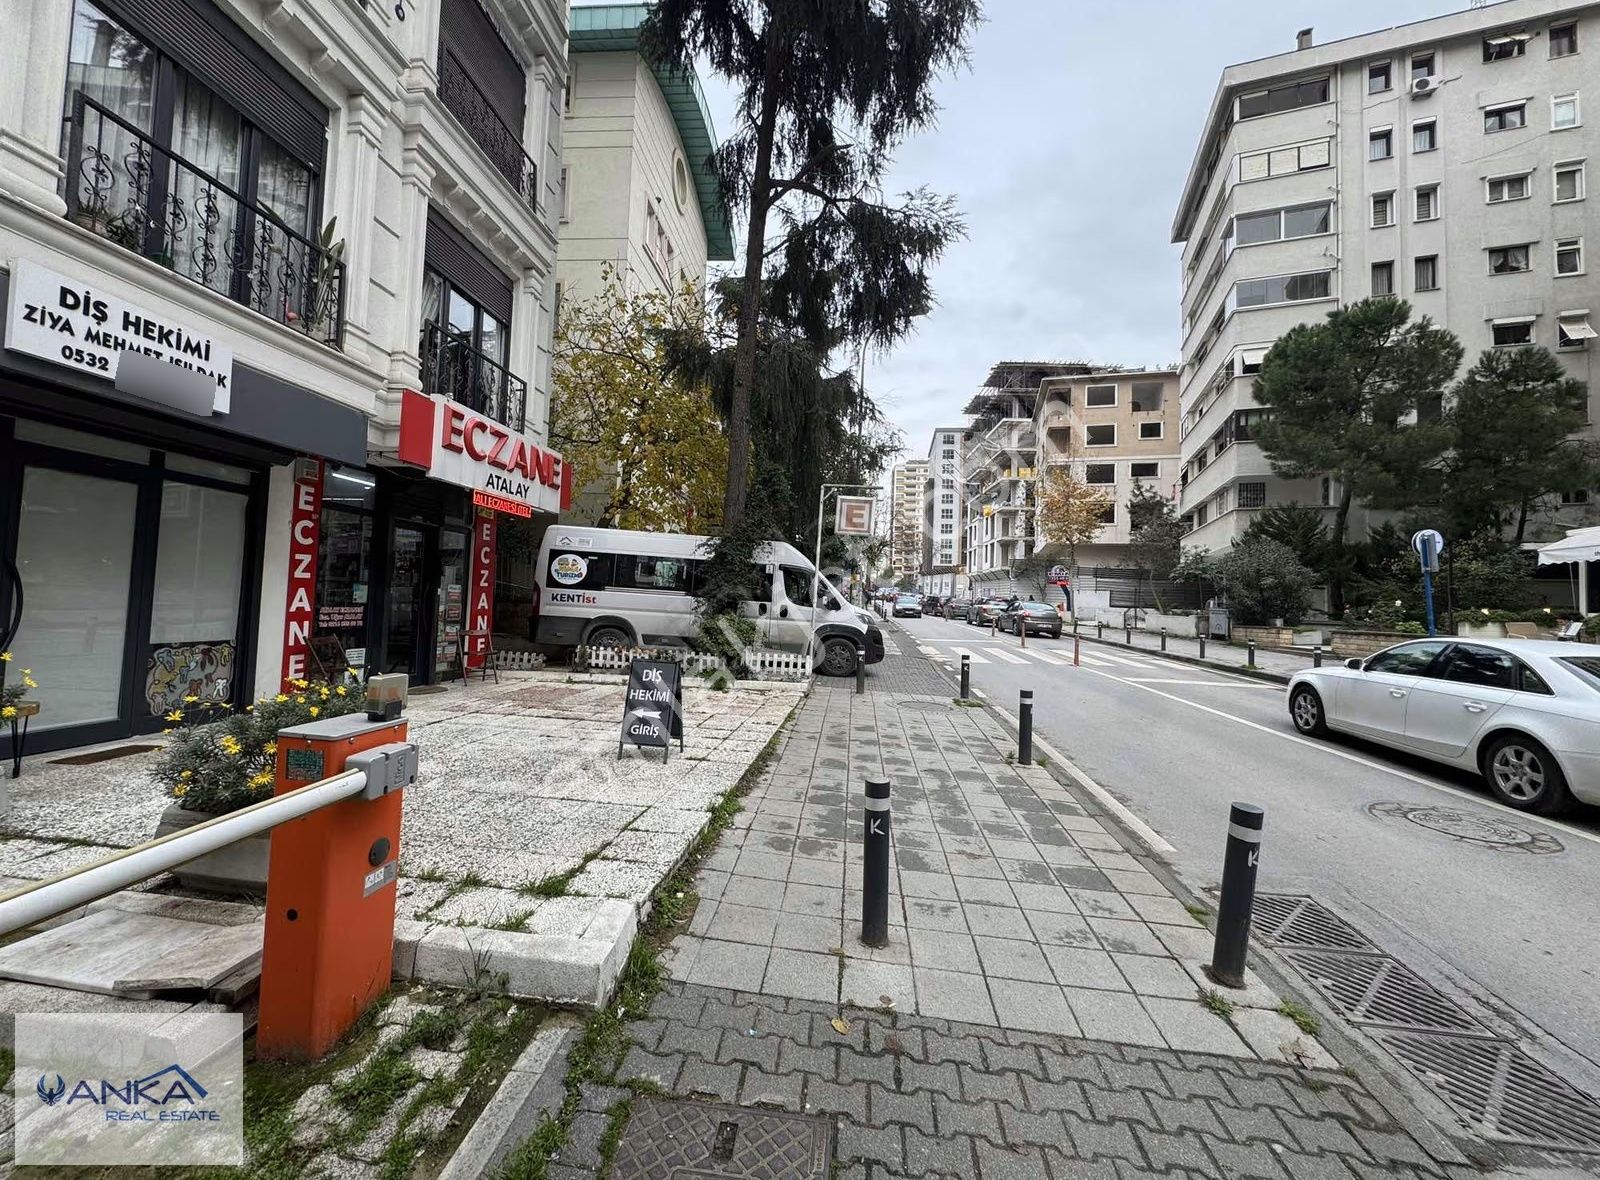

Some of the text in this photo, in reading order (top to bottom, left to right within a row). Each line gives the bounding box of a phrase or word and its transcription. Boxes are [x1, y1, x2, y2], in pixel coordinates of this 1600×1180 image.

[22, 303, 76, 337] ZİYA
[59, 285, 211, 362] DİŞ HEKİMİ
[61, 344, 110, 372] 0532
[442, 403, 563, 490] ECZANE
[485, 472, 530, 499] ATALAY
[845, 505, 867, 528] E
[287, 484, 315, 679] ECZANE
[641, 667, 663, 684] DİŞ
[629, 687, 670, 703] HEKİMİ
[630, 723, 660, 739] GİRİŞ
[869, 817, 885, 836] K
